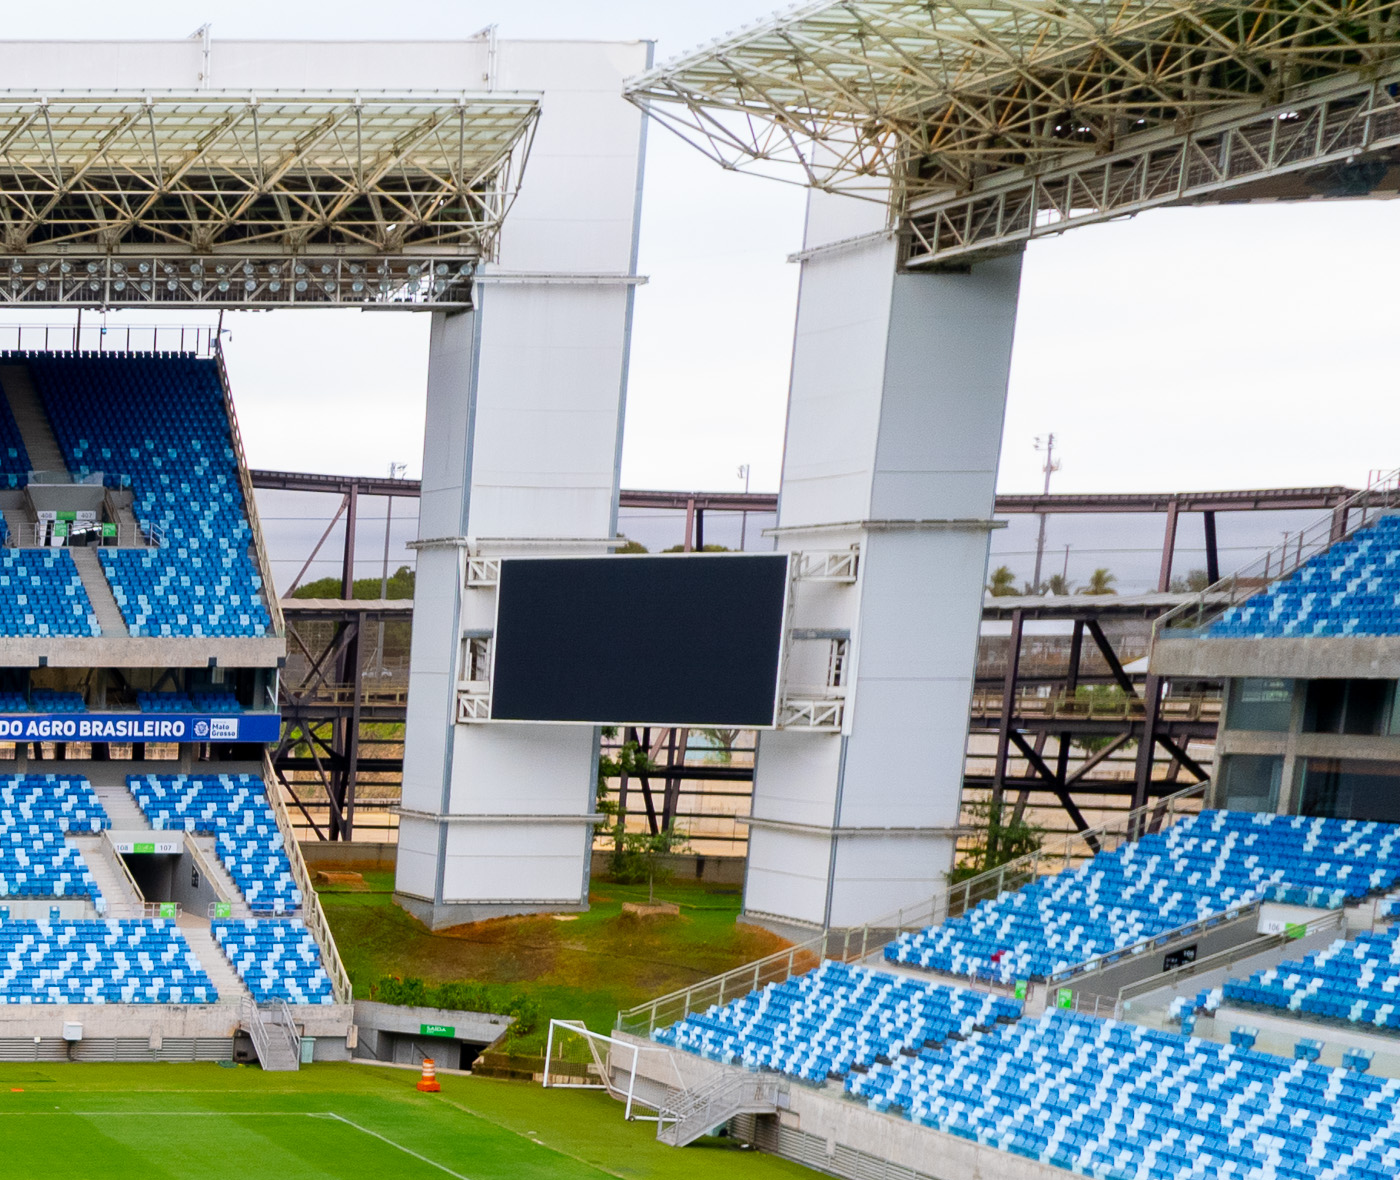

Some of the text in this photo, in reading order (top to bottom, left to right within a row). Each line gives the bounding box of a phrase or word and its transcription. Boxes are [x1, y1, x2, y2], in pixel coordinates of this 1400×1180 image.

[25, 720, 76, 736] AGRO
[79, 720, 185, 737] BRASILEIRO
[1268, 922, 1279, 931] 106
